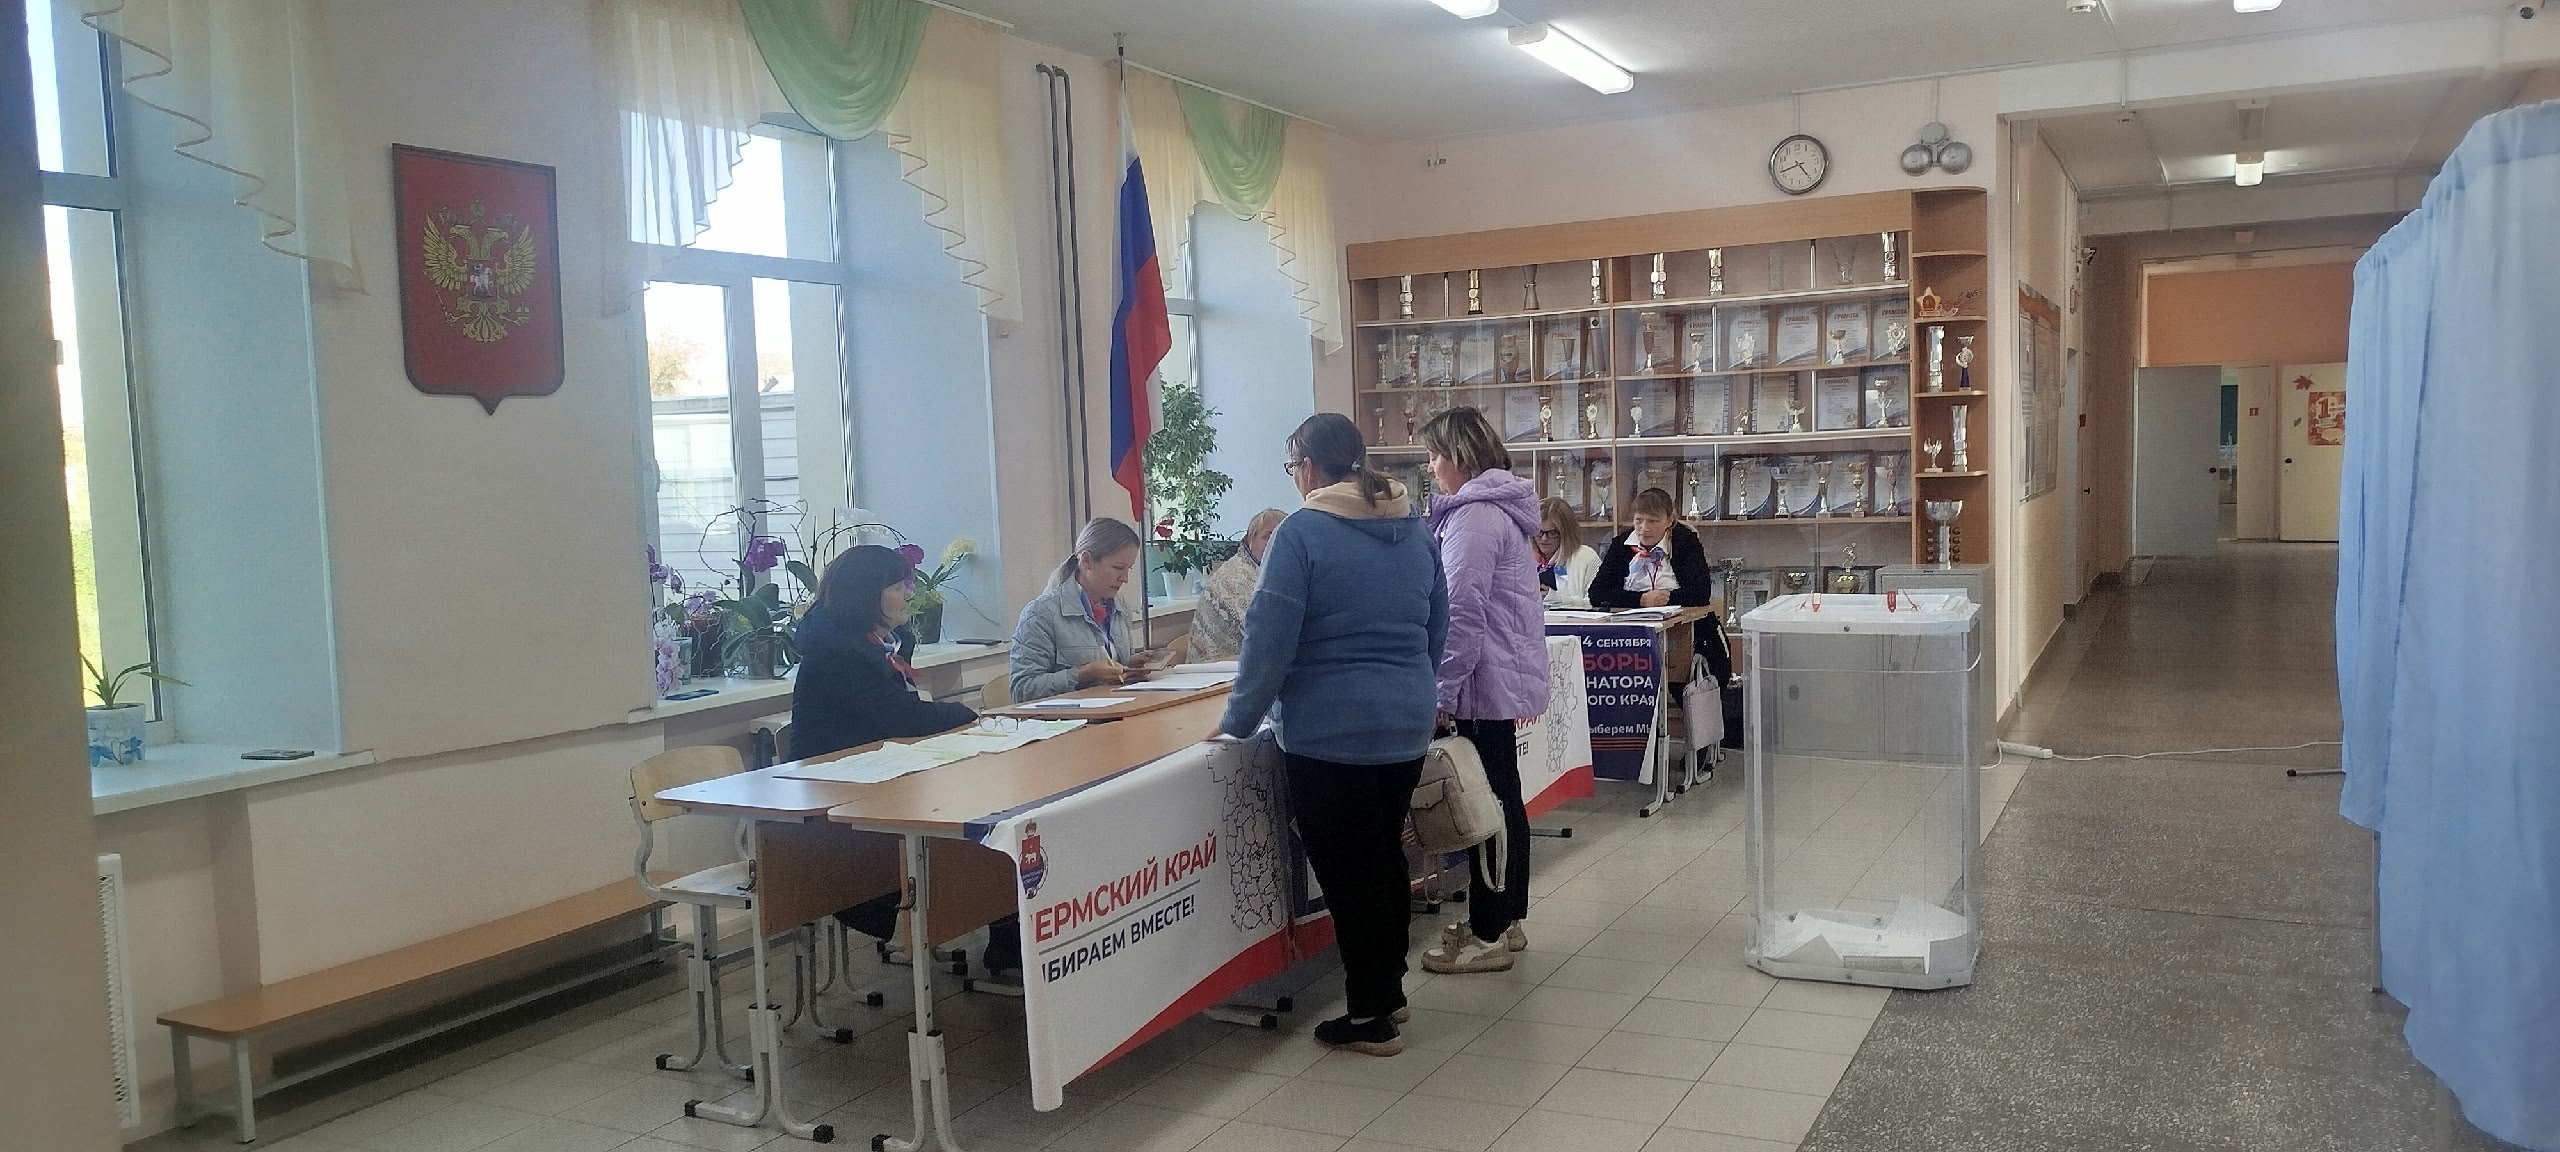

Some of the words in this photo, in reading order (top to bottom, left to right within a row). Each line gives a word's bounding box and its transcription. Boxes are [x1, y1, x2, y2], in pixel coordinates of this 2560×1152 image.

[2318, 398, 2331, 419] 1
[1582, 635, 1594, 648] 4
[1596, 638, 1652, 648] СЕНТЯБРЯ
[1583, 652, 1653, 672] БОРЫ
[1586, 675, 1654, 690] НАТОРА
[1587, 694, 1617, 706] ОГО
[1620, 694, 1655, 706] КРАЯ
[1031, 857, 1158, 944] ЕРМСКИЙ
[1165, 830, 1217, 886] КРАЙ
[1042, 928, 1126, 983] БИРАЕМ
[1131, 894, 1196, 945] ВМЕСТЕ!
